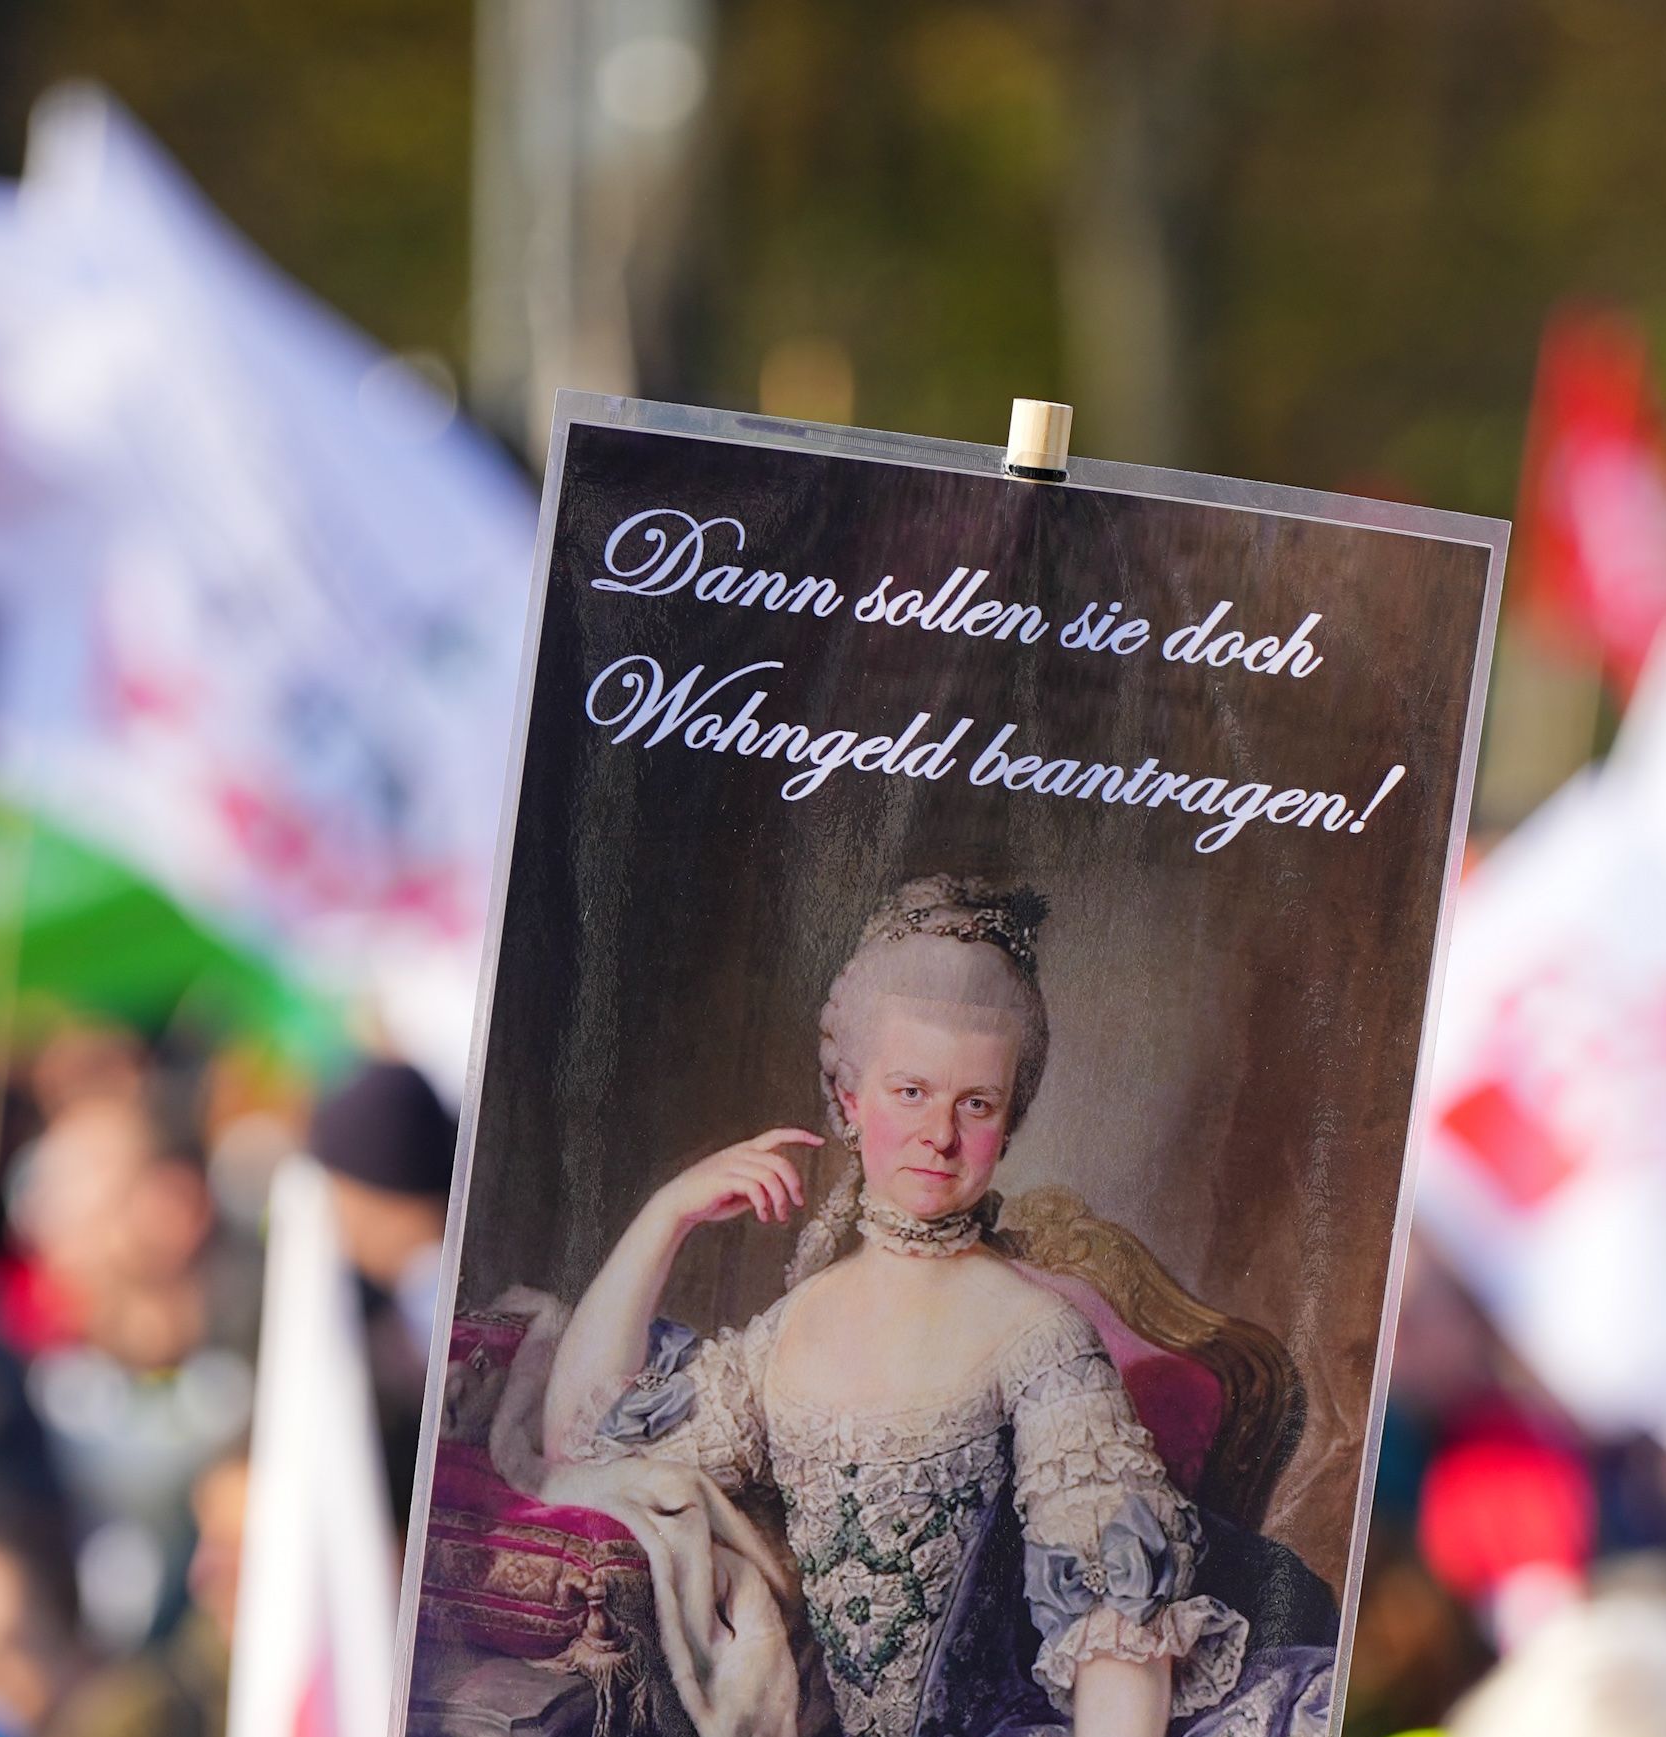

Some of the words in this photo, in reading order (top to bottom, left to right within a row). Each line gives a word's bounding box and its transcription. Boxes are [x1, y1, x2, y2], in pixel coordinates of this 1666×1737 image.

[590, 508, 844, 618] Dann
[854, 566, 1050, 644] sollen
[1059, 601, 1151, 655] sie
[1162, 600, 1324, 678] doch
[584, 654, 975, 802] Wohngeld
[968, 723, 1406, 854] beantragen!
